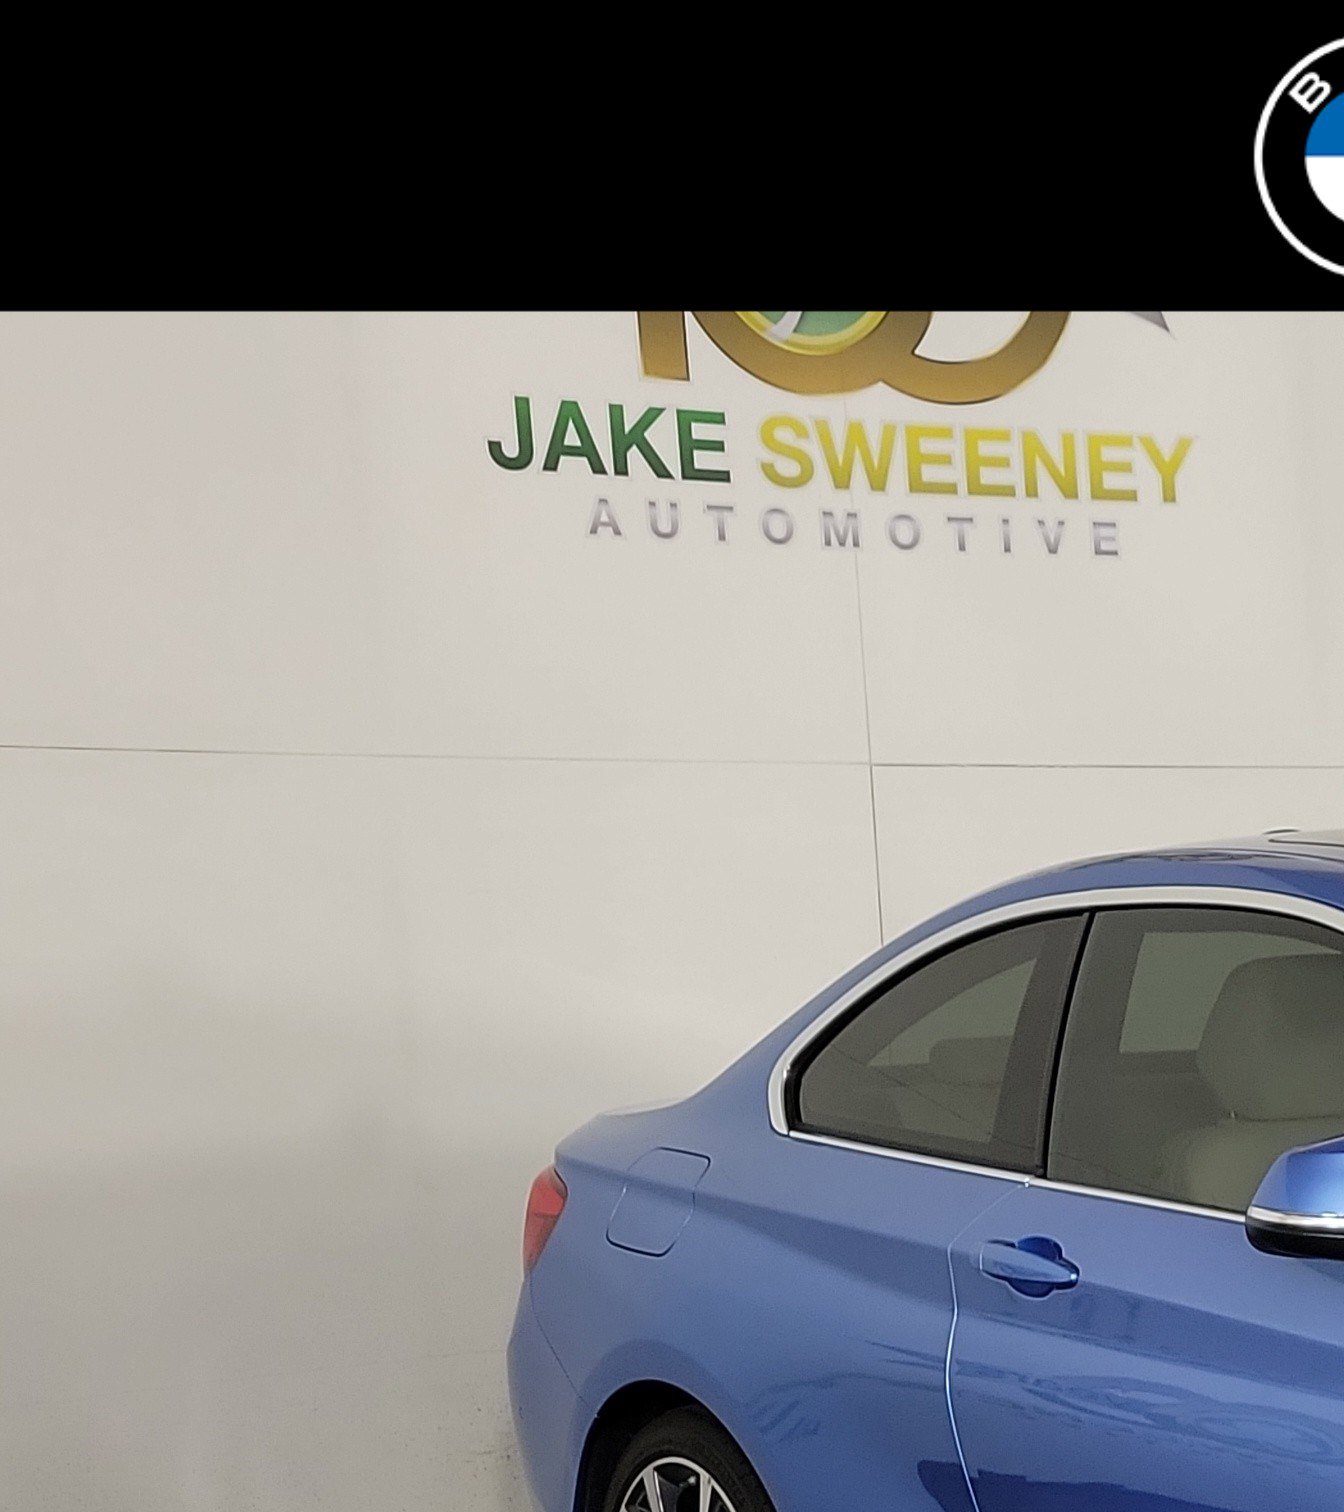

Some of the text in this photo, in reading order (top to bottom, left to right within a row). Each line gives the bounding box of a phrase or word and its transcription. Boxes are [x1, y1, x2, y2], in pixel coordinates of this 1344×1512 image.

[487, 396, 1195, 504] JAKE SWEENEY
[588, 498, 1121, 557] AUTOMOTIVE
